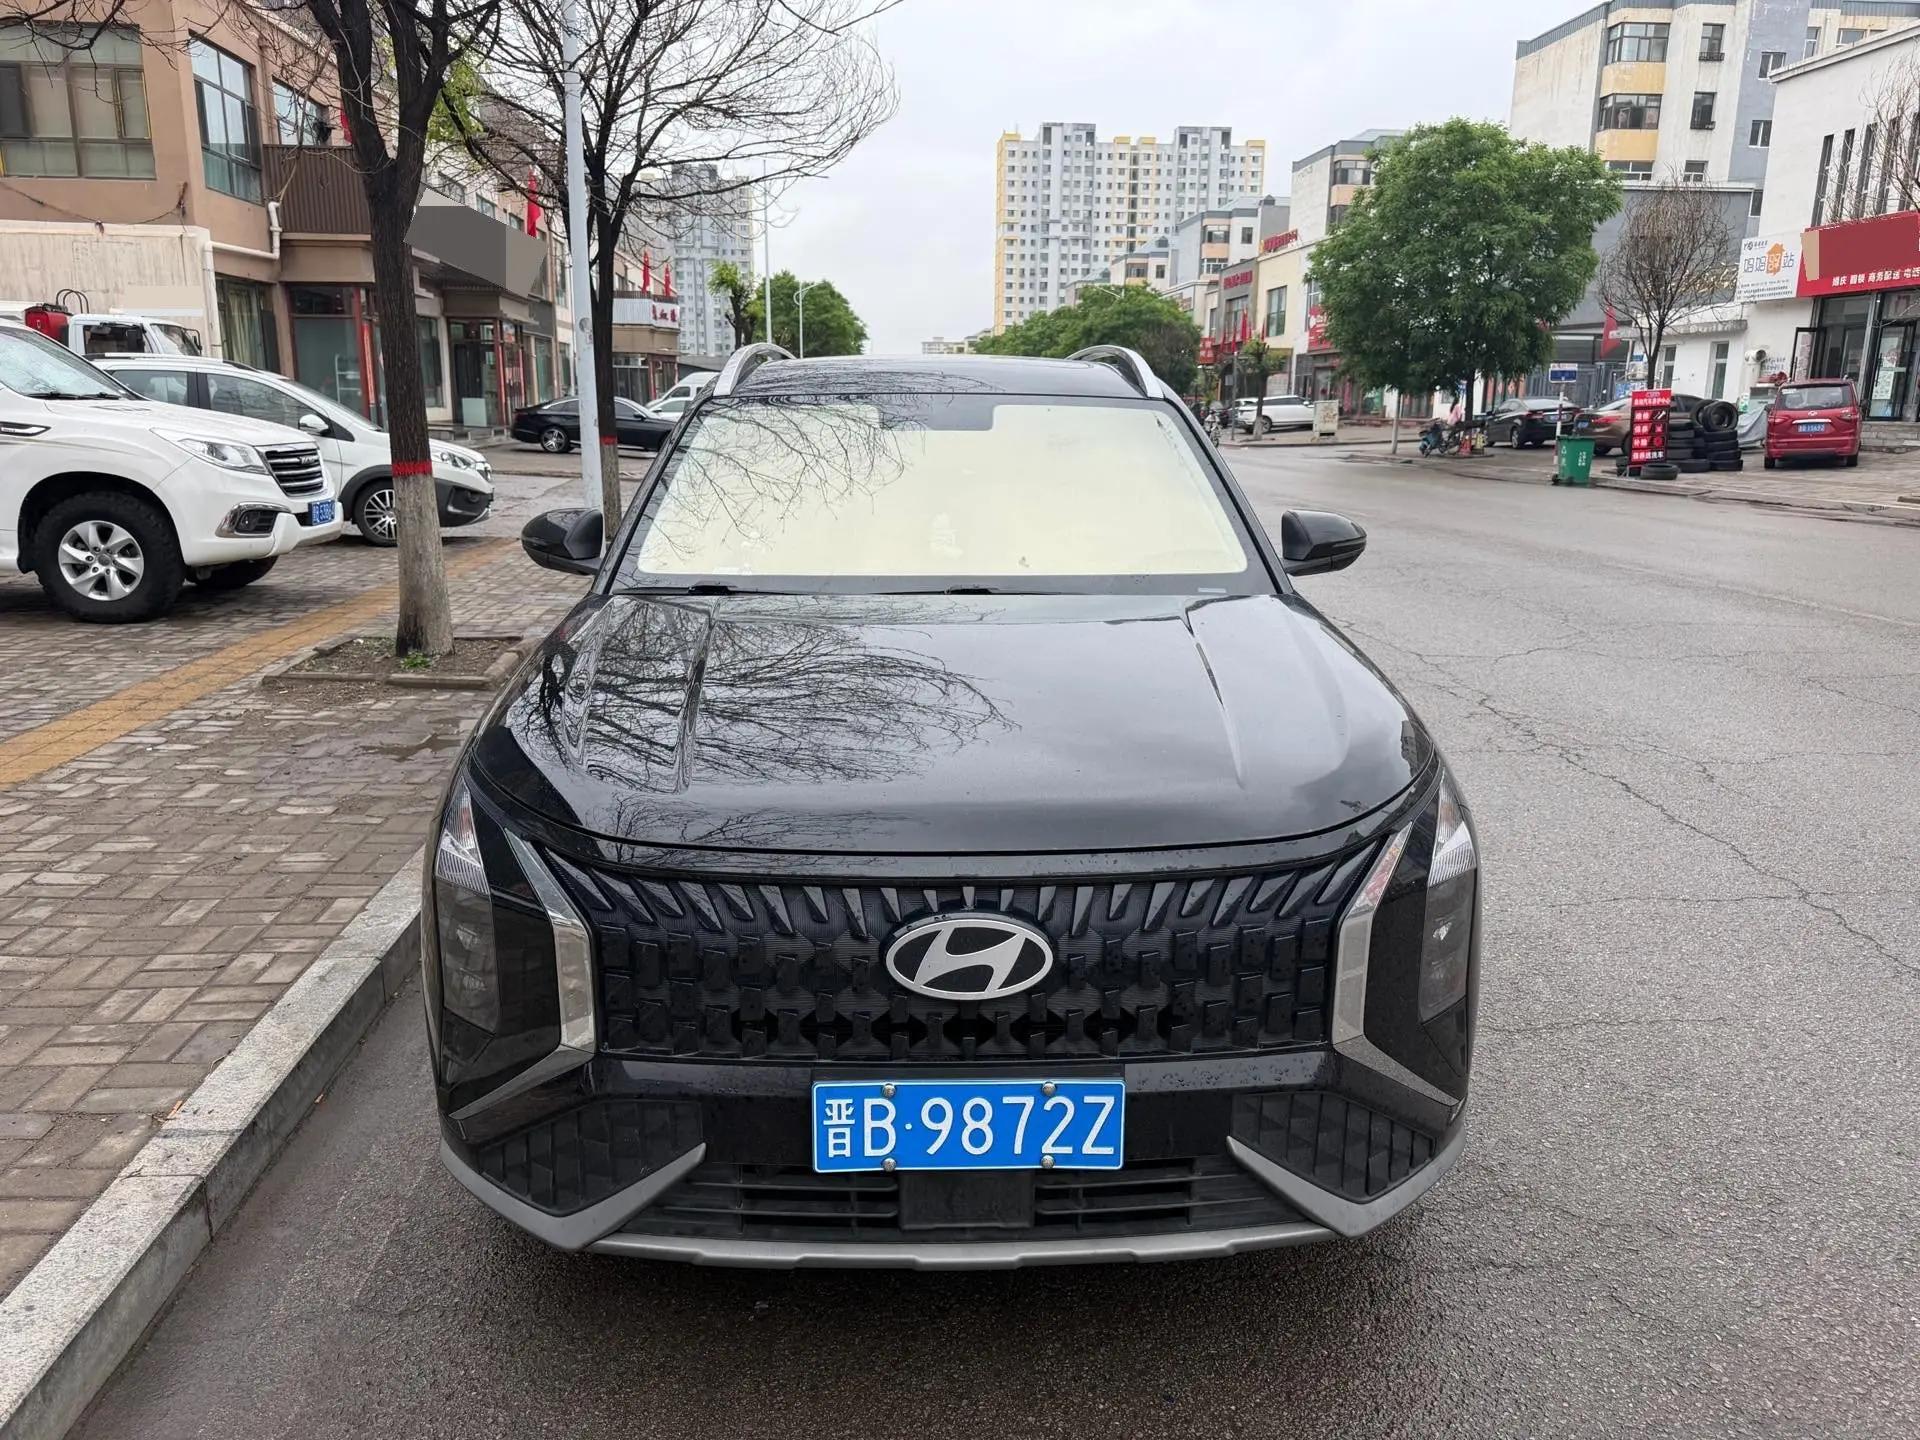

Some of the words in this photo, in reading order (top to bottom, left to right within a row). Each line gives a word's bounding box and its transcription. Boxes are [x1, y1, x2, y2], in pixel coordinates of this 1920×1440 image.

[1743, 252, 1795, 274] 妈妈驿站
[1868, 269, 1900, 283] 商务配送
[823, 1096, 1116, 1158] 晋B·9872Z
